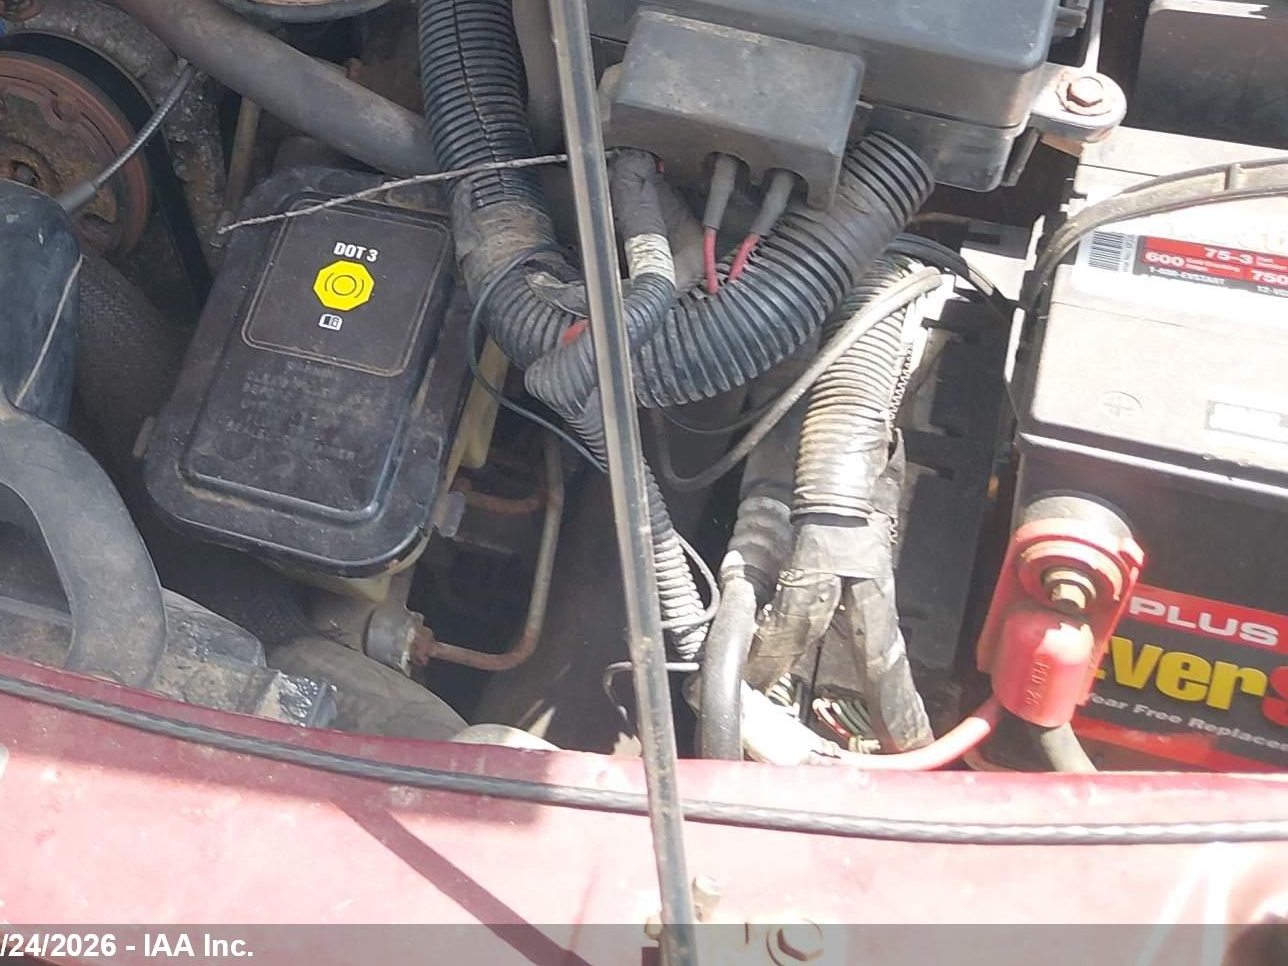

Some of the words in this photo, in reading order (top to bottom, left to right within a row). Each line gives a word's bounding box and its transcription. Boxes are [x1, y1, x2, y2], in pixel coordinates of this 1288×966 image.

[333, 242, 365, 260] DOT
[366, 249, 379, 262] 3
[1144, 251, 1185, 268] 600
[1250, 268, 1288, 286] 750
[1128, 595, 1279, 647] PLUS
[1096, 634, 1288, 728] ver
[1132, 703, 1184, 724] Free
